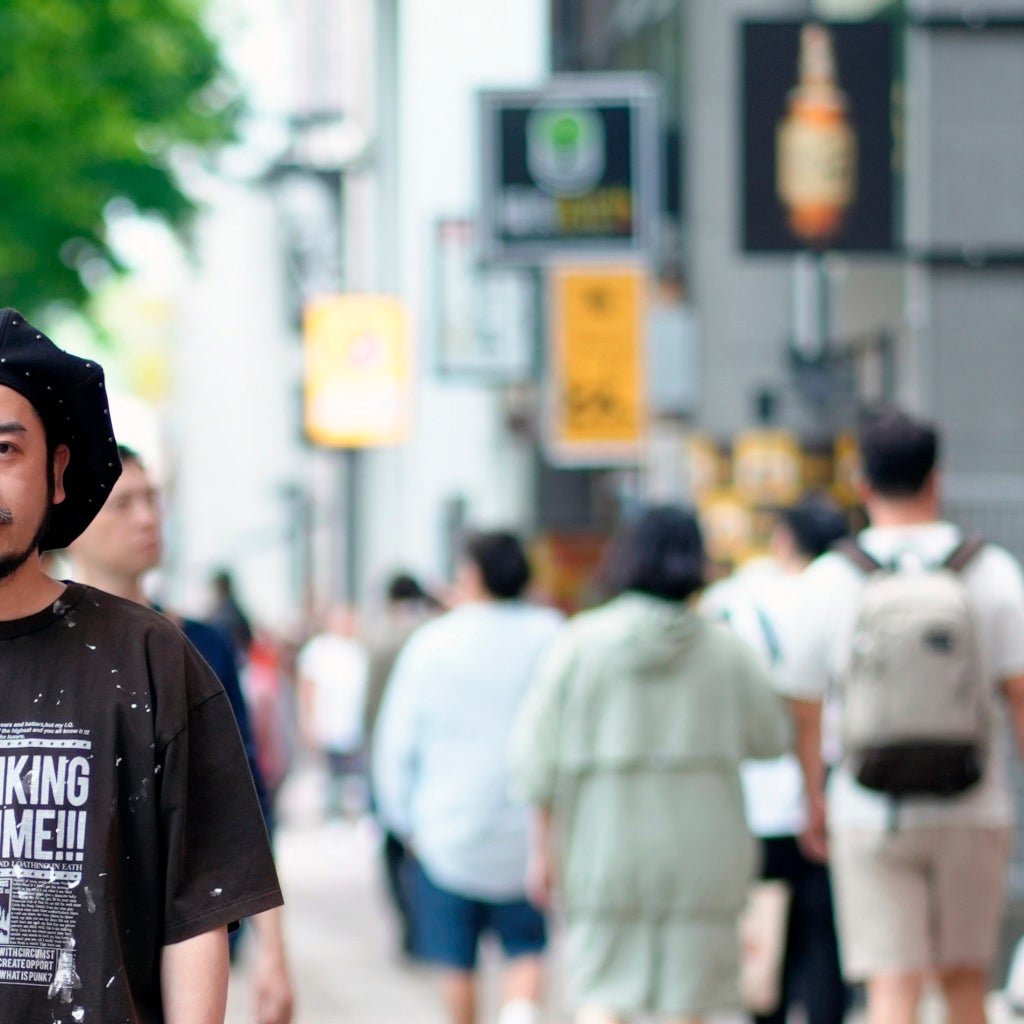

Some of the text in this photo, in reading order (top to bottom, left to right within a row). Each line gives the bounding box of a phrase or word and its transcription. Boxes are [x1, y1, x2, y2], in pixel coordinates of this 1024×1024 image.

[19, 948, 55, 960] CIRCUMST
[26, 960, 53, 971] OPPORT
[0, 970, 21, 980] WHAT
[21, 971, 30, 981] IS
[29, 972, 53, 983] PUNK?
